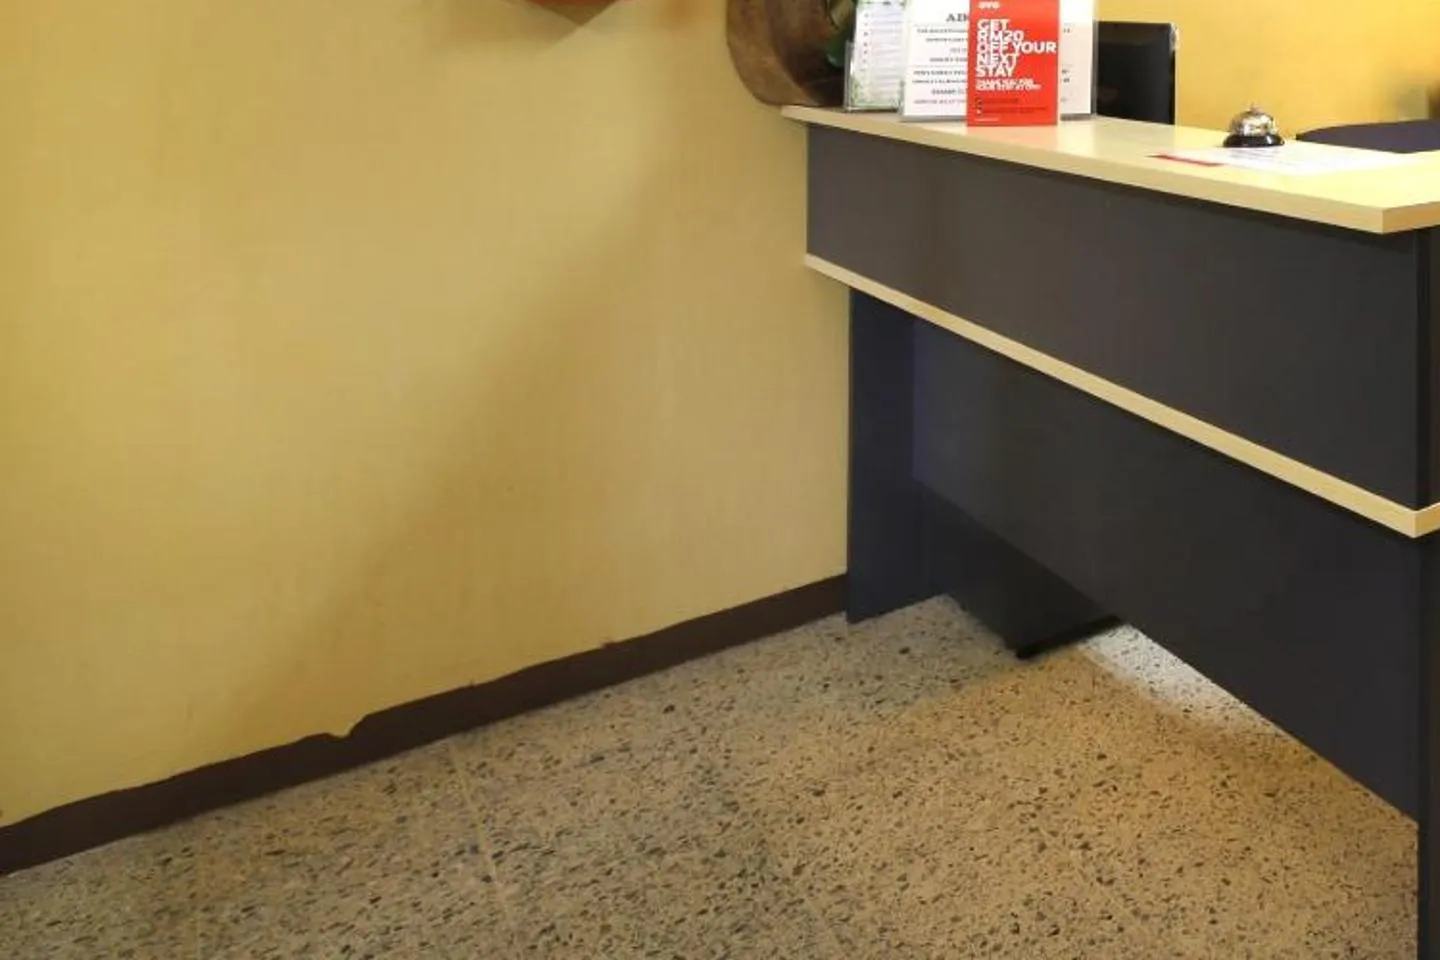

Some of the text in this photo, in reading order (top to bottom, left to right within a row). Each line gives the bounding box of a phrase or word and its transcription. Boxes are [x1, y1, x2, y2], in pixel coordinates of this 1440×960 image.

[977, 19, 1010, 30] GET
[977, 29, 1024, 42] RM20
[977, 41, 1057, 54] OFF YOUR
[977, 53, 1018, 66] NEXT
[975, 65, 1014, 78] STAY
